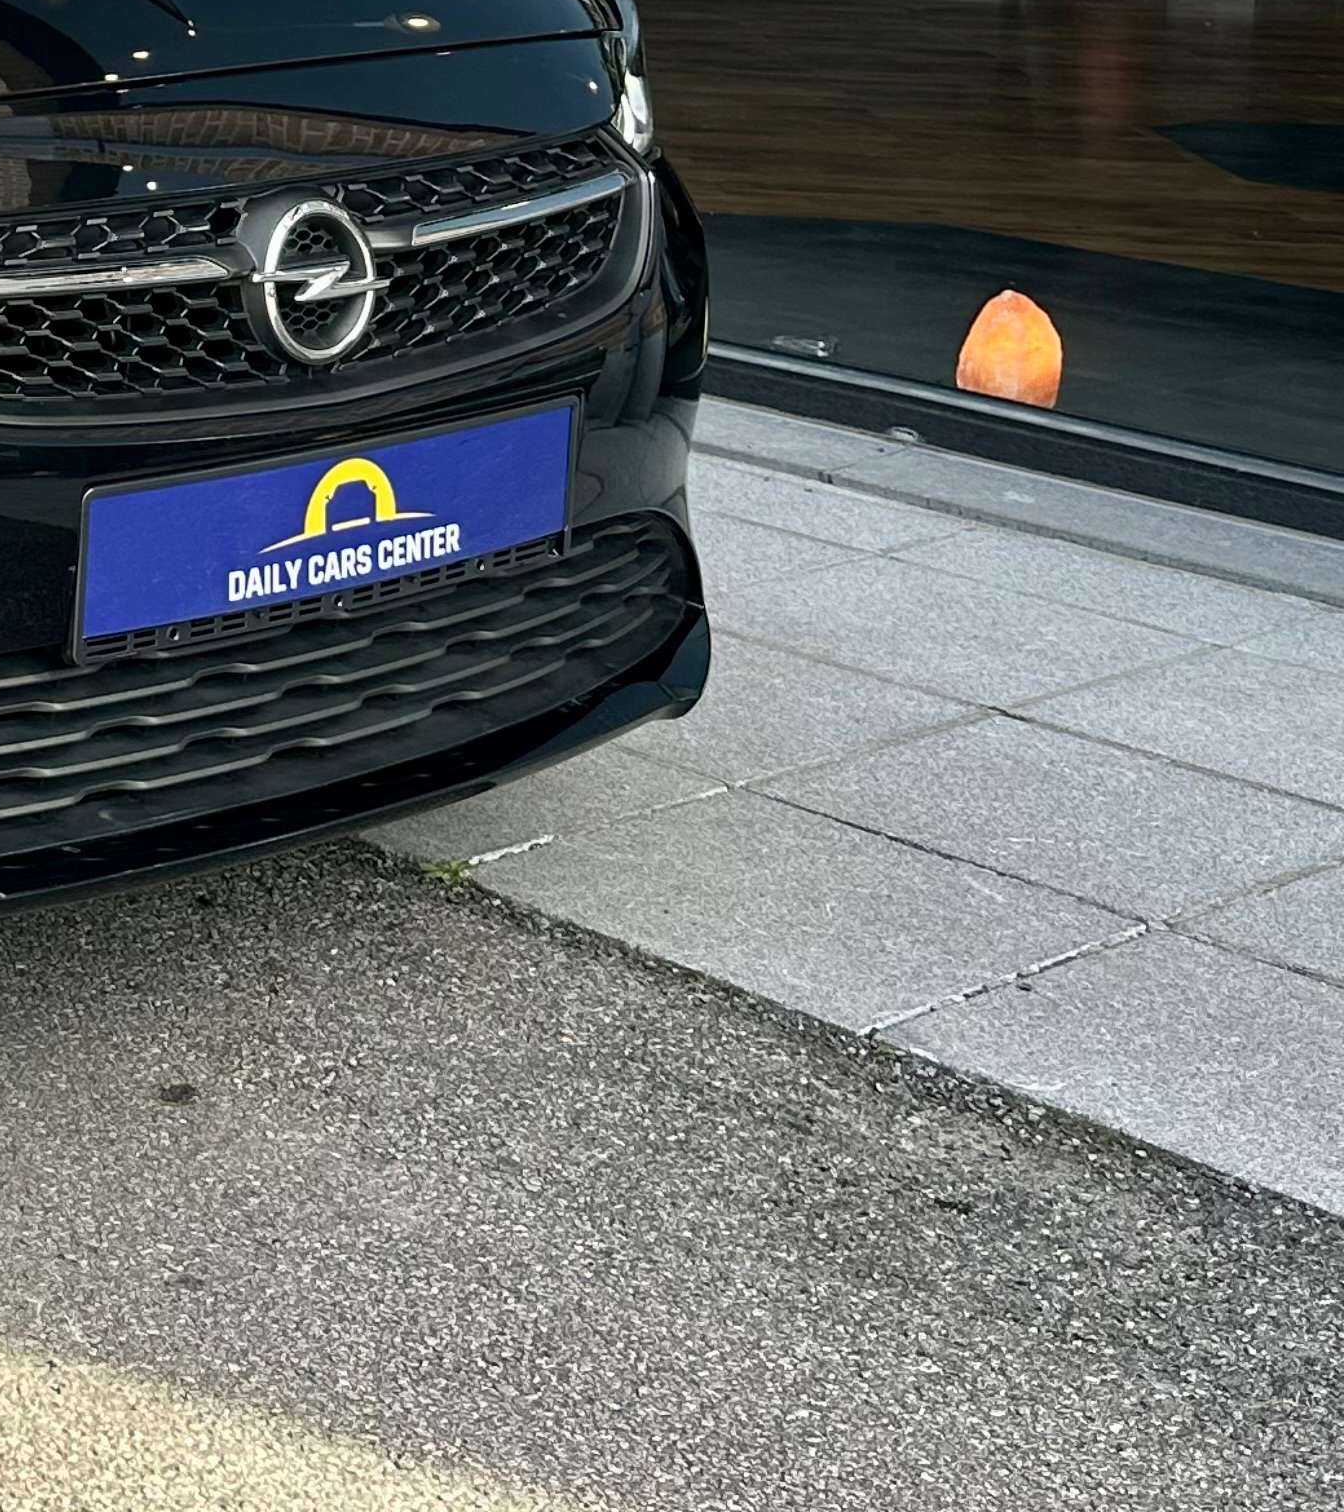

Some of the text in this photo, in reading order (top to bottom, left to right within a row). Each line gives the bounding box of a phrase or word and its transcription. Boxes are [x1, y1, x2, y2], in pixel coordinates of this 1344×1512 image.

[228, 523, 462, 602] DAILY CARS CENTER
